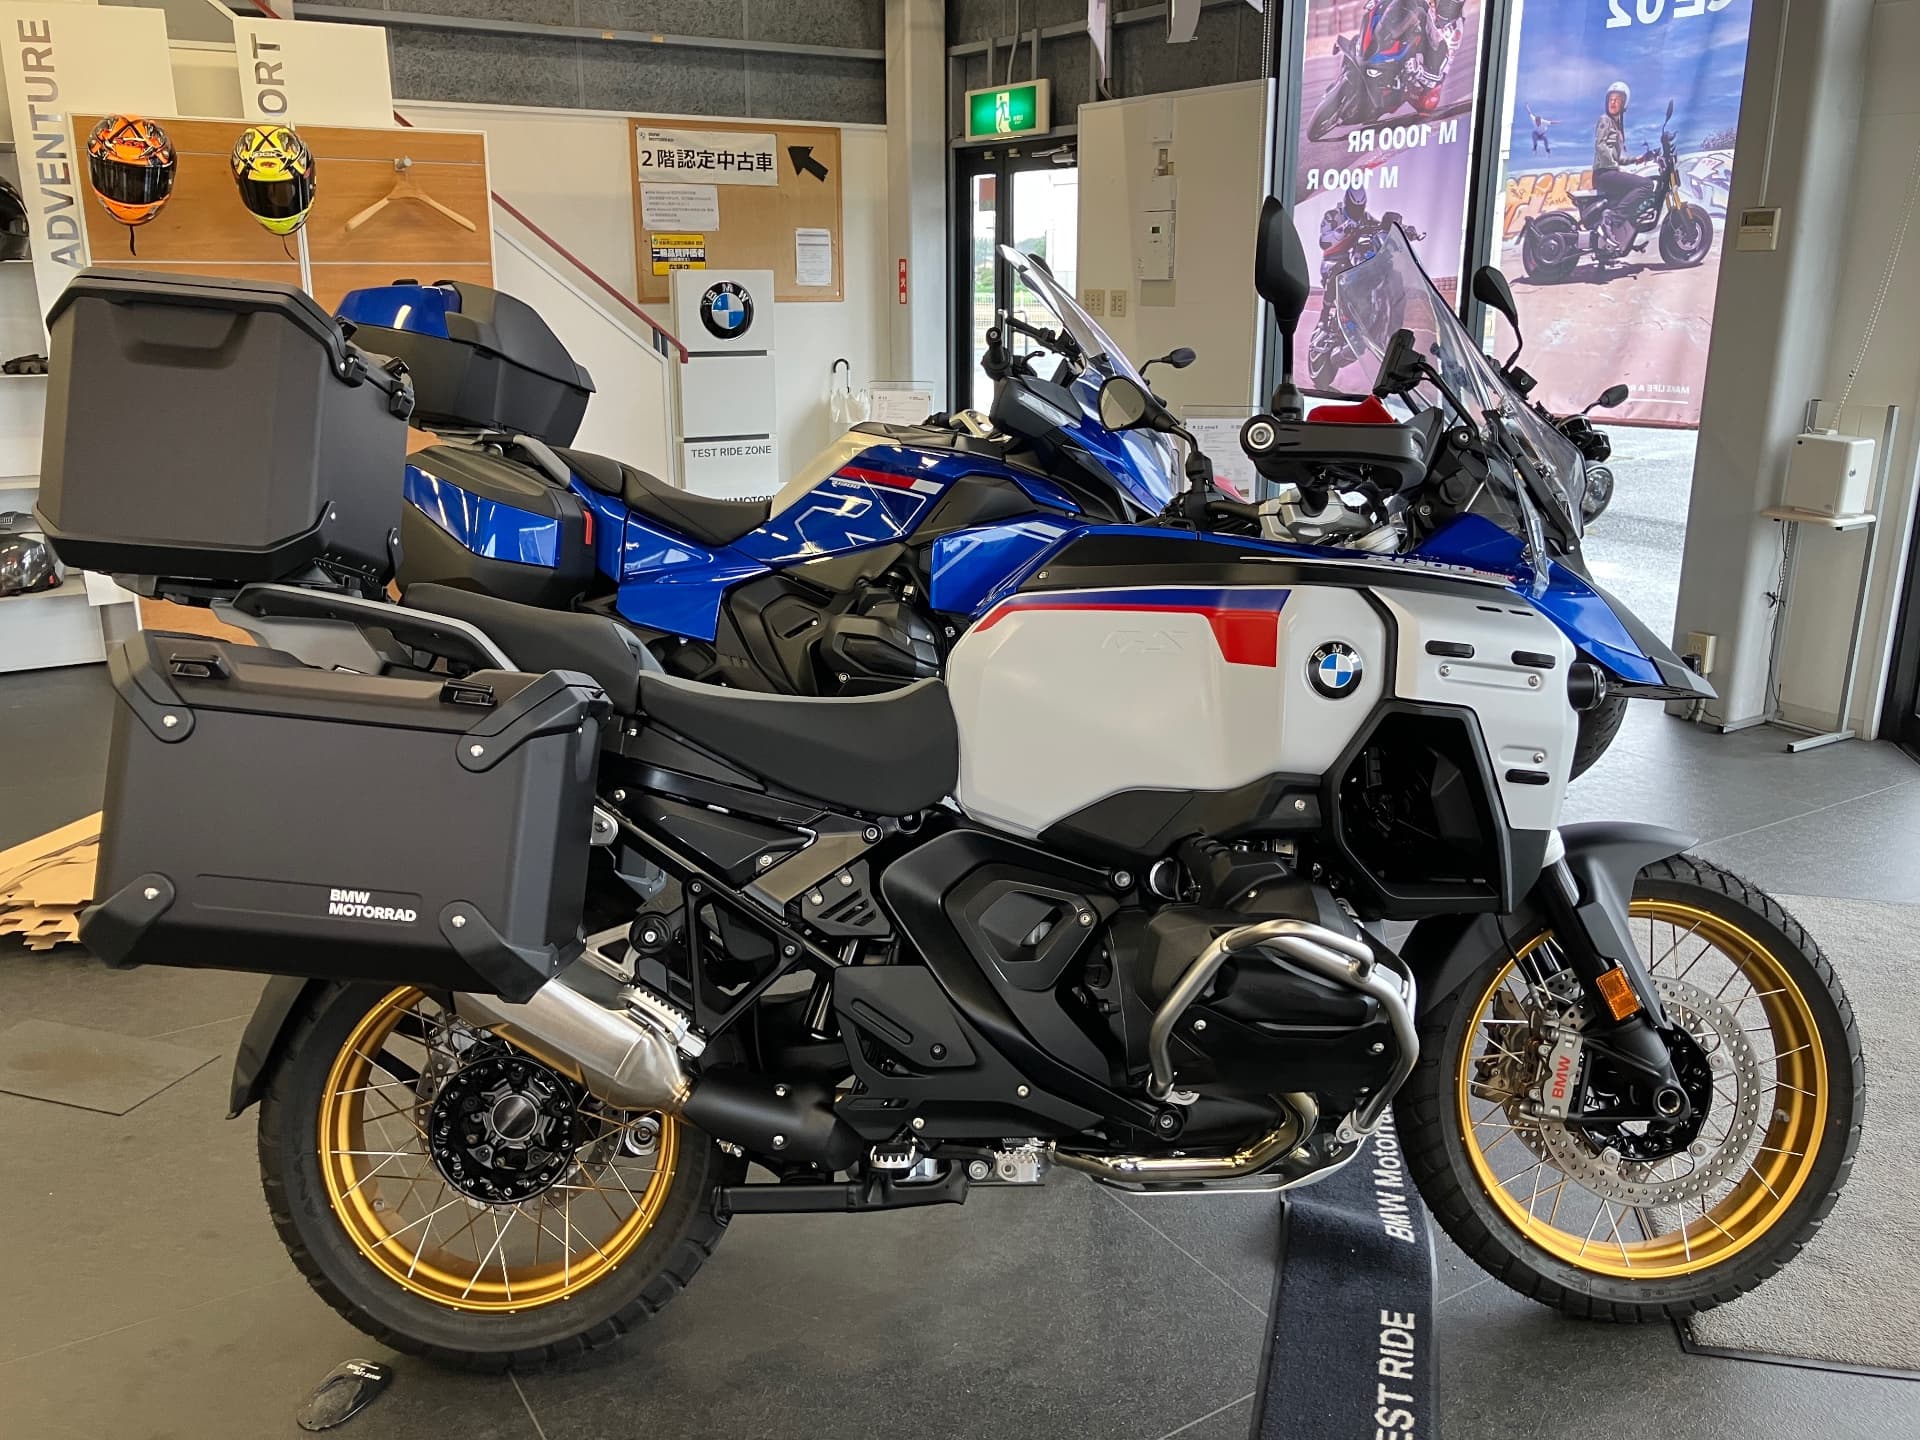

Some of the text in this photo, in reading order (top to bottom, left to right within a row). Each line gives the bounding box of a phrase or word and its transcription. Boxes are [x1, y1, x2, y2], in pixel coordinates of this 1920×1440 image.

[250, 33, 288, 116] ORT
[17, 19, 84, 269] ADVENTURE
[641, 149, 774, 172] 2階認定中古車
[705, 282, 749, 302] BMW
[691, 445, 772, 458] TEST RIDE ZONE
[1313, 643, 1361, 664] BMW
[330, 888, 370, 904] BMW
[328, 902, 417, 922] MOTORRAD
[1551, 1055, 1572, 1099] BMW
[1376, 1191, 1415, 1244] BMW
[1378, 1309, 1416, 1380] RIDE
